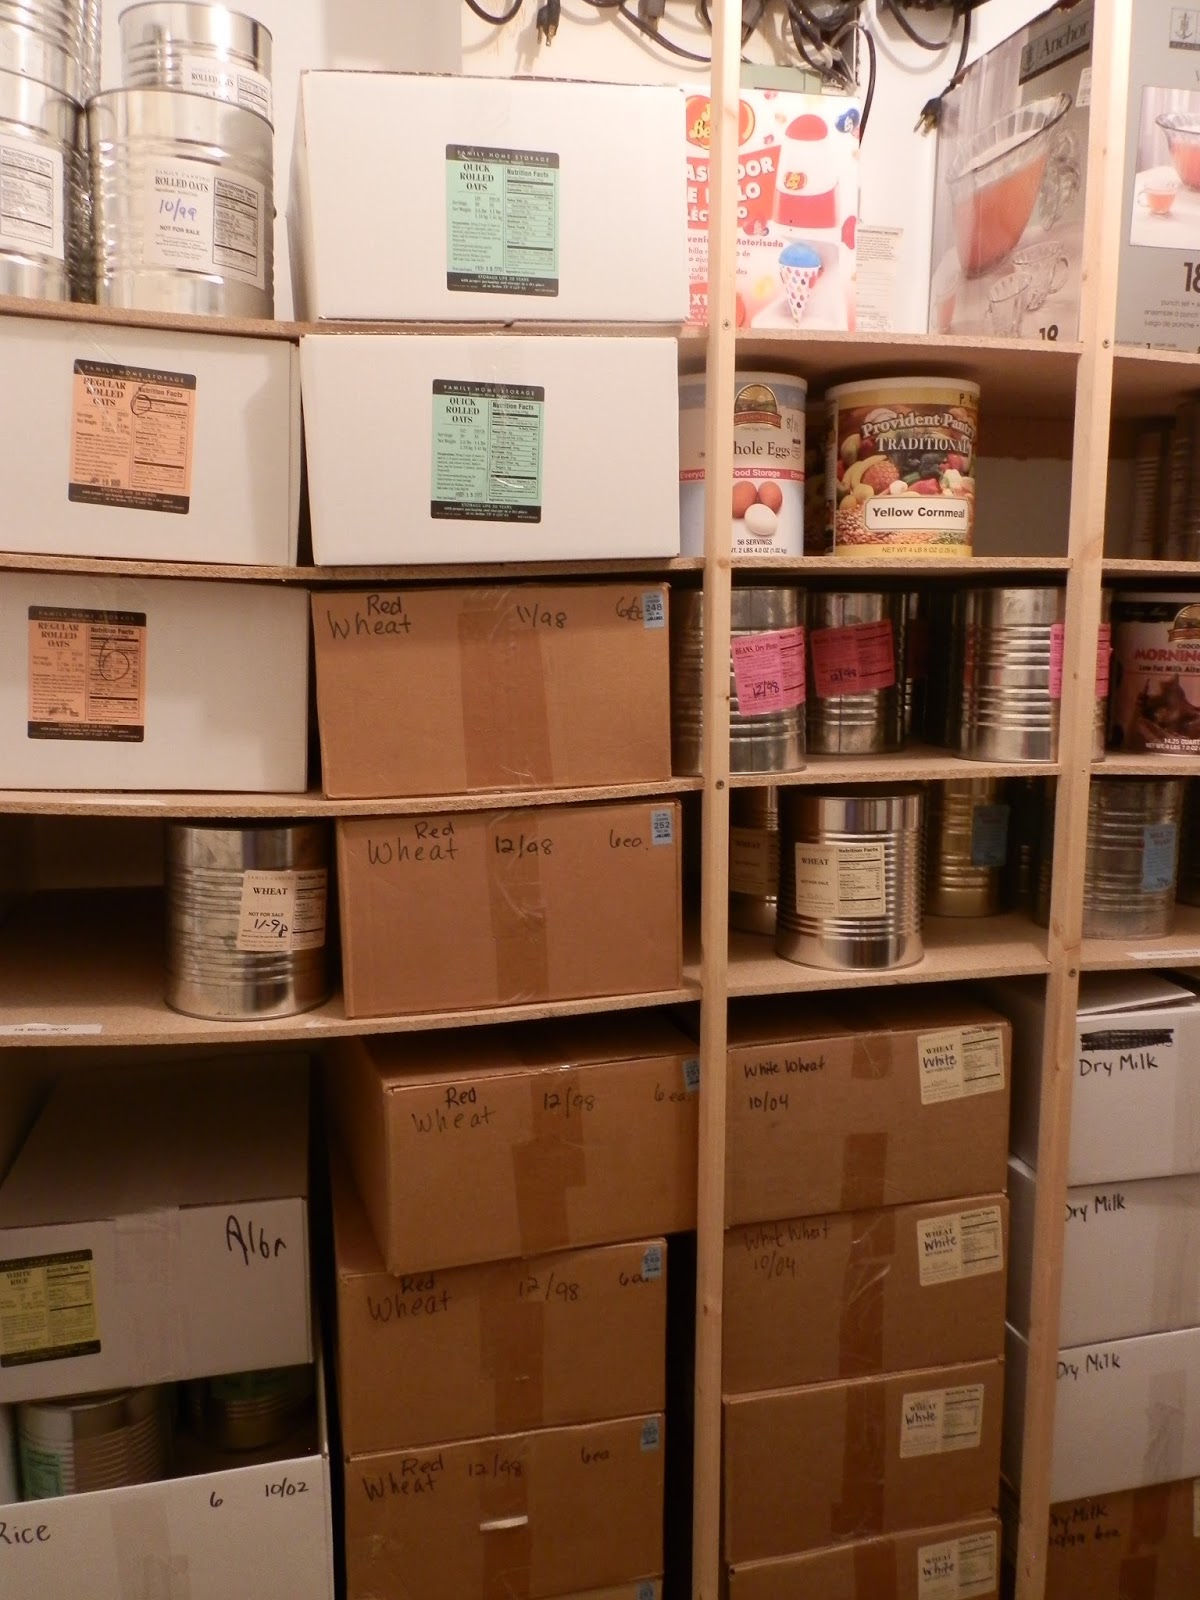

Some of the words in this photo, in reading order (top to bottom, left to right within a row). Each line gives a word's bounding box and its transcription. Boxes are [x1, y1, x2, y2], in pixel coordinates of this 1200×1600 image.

[1041, 20, 1090, 56] Anchor
[463, 163, 490, 172] QUICK
[507, 168, 531, 177] Nutrition
[534, 170, 549, 178] Facts
[155, 175, 187, 188] ROLLED
[188, 180, 209, 192] OATS
[460, 173, 494, 182] ROLLED
[466, 182, 487, 191] OATS
[159, 198, 197, 221] 10/99
[185, 228, 200, 236] SALE
[84, 364, 114, 372] FAMILY
[147, 374, 184, 383] STORAGE
[83, 377, 126, 390] REGULAR
[86, 387, 123, 398] ROLLED
[138, 387, 164, 396] Nutrition
[166, 390, 183, 398] Facts
[93, 398, 116, 406] OATS
[450, 397, 476, 406] QUICK
[492, 402, 517, 410] Nutrition
[446, 406, 480, 415] ROLLED
[861, 412, 940, 437] Provident
[733, 441, 763, 455] hole
[767, 442, 790, 458] Eggs
[876, 438, 968, 453] TRADITIONAL
[752, 469, 781, 478] Storage
[872, 507, 913, 517] Yellow
[917, 507, 965, 518] Cornmeal
[367, 594, 402, 616] Red
[38, 622, 79, 631] REGULAR
[327, 611, 411, 640] Wheat
[41, 631, 77, 639] ROLLED
[1134, 648, 1200, 661] MORNIN
[752, 680, 780, 698] 12/98
[654, 821, 671, 829] 252
[415, 820, 454, 840] Red
[495, 834, 553, 859] 12/98
[367, 837, 458, 865] Wheat
[252, 887, 288, 895] WHEAT
[925, 1044, 954, 1054] WHEAT
[744, 1060, 779, 1079] White
[785, 1055, 826, 1072] Wheat
[922, 1054, 957, 1069] White
[1078, 1059, 1112, 1076] Dry
[1119, 1053, 1158, 1070] Milk
[444, 1086, 476, 1109] Red
[543, 1086, 595, 1118] 12/98
[749, 1090, 789, 1112] 10/04
[411, 1105, 496, 1134] Wheat
[1095, 1193, 1126, 1214] Milk
[925, 1228, 953, 1238] WHEAT
[924, 1236, 957, 1251] White
[6, 1271, 30, 1279] WHITE
[10, 1278, 28, 1286] RICE
[401, 1274, 435, 1294] Red
[519, 1271, 580, 1300] 12/98
[367, 1289, 452, 1323] Wheat
[1086, 1353, 1121, 1373] Milk
[905, 1411, 936, 1425] White
[401, 1453, 444, 1476] Red
[468, 1453, 523, 1478] 12/98
[209, 1491, 223, 1508] 6
[265, 1477, 309, 1498] 10/02
[362, 1472, 436, 1501] Wheat
[0, 1523, 51, 1545] Rice
[923, 1562, 955, 1577] White
